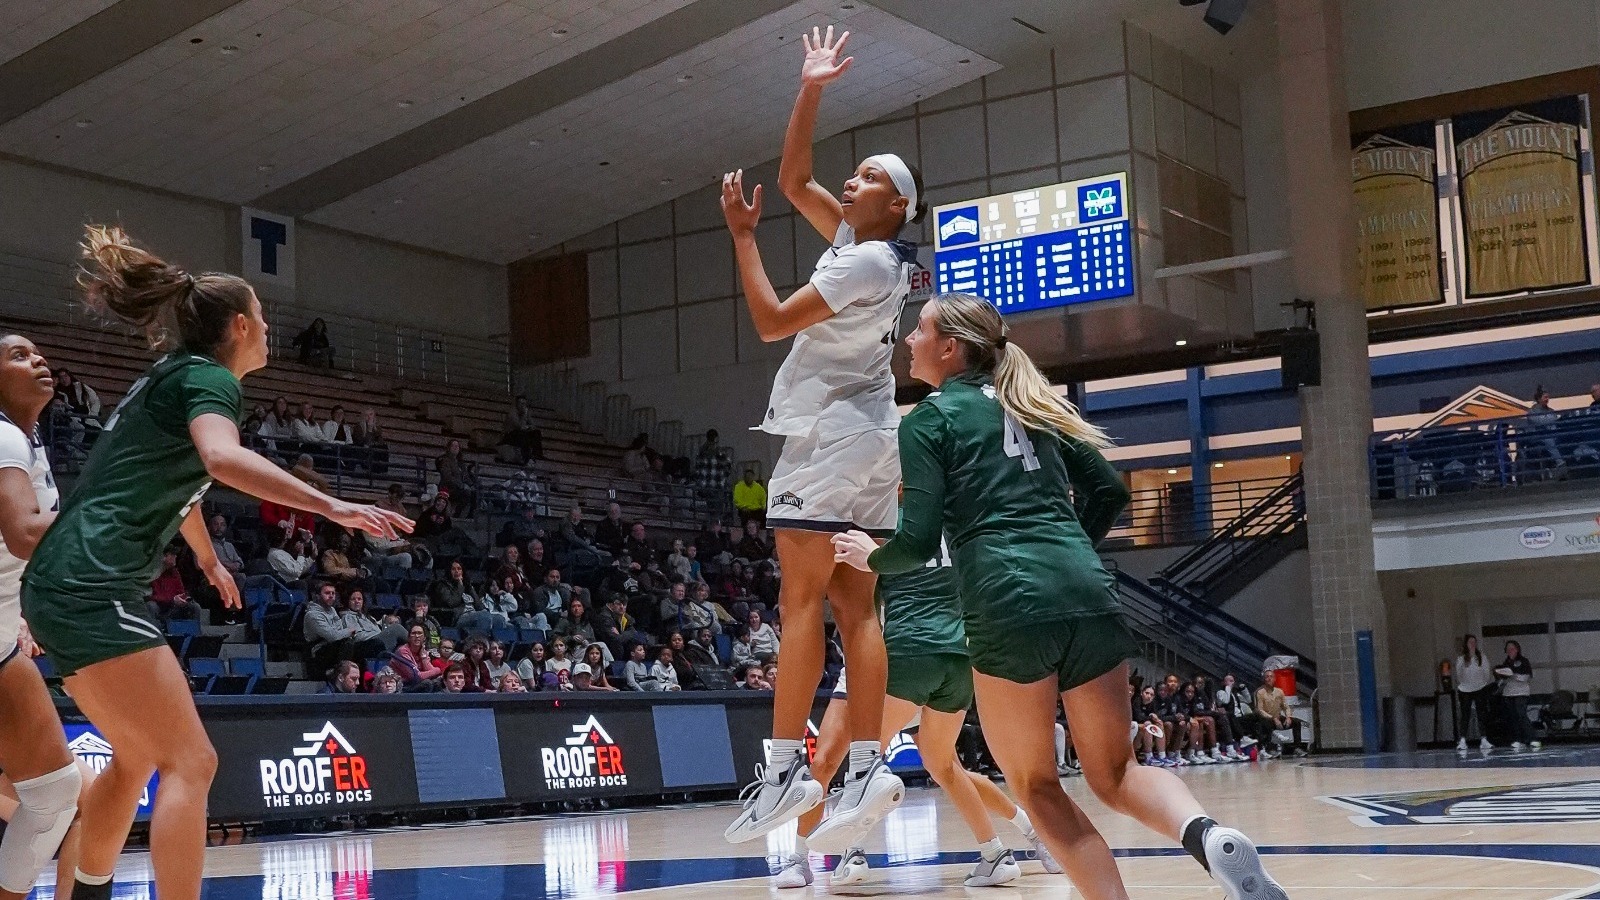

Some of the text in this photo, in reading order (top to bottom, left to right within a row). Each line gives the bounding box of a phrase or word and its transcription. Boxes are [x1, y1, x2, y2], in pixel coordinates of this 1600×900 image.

[1367, 150, 1433, 178] MOUNT
[1462, 134, 1498, 173] THE
[1504, 127, 1574, 156] MOUNT
[251, 216, 286, 276] T
[1003, 408, 1041, 471] 4
[608, 489, 616, 499] 10
[260, 756, 369, 794] ROOFER
[541, 745, 625, 779] ROOFER
[263, 789, 372, 807] THE ROOF DOCS
[545, 775, 628, 790] THE ROOF DOCS
